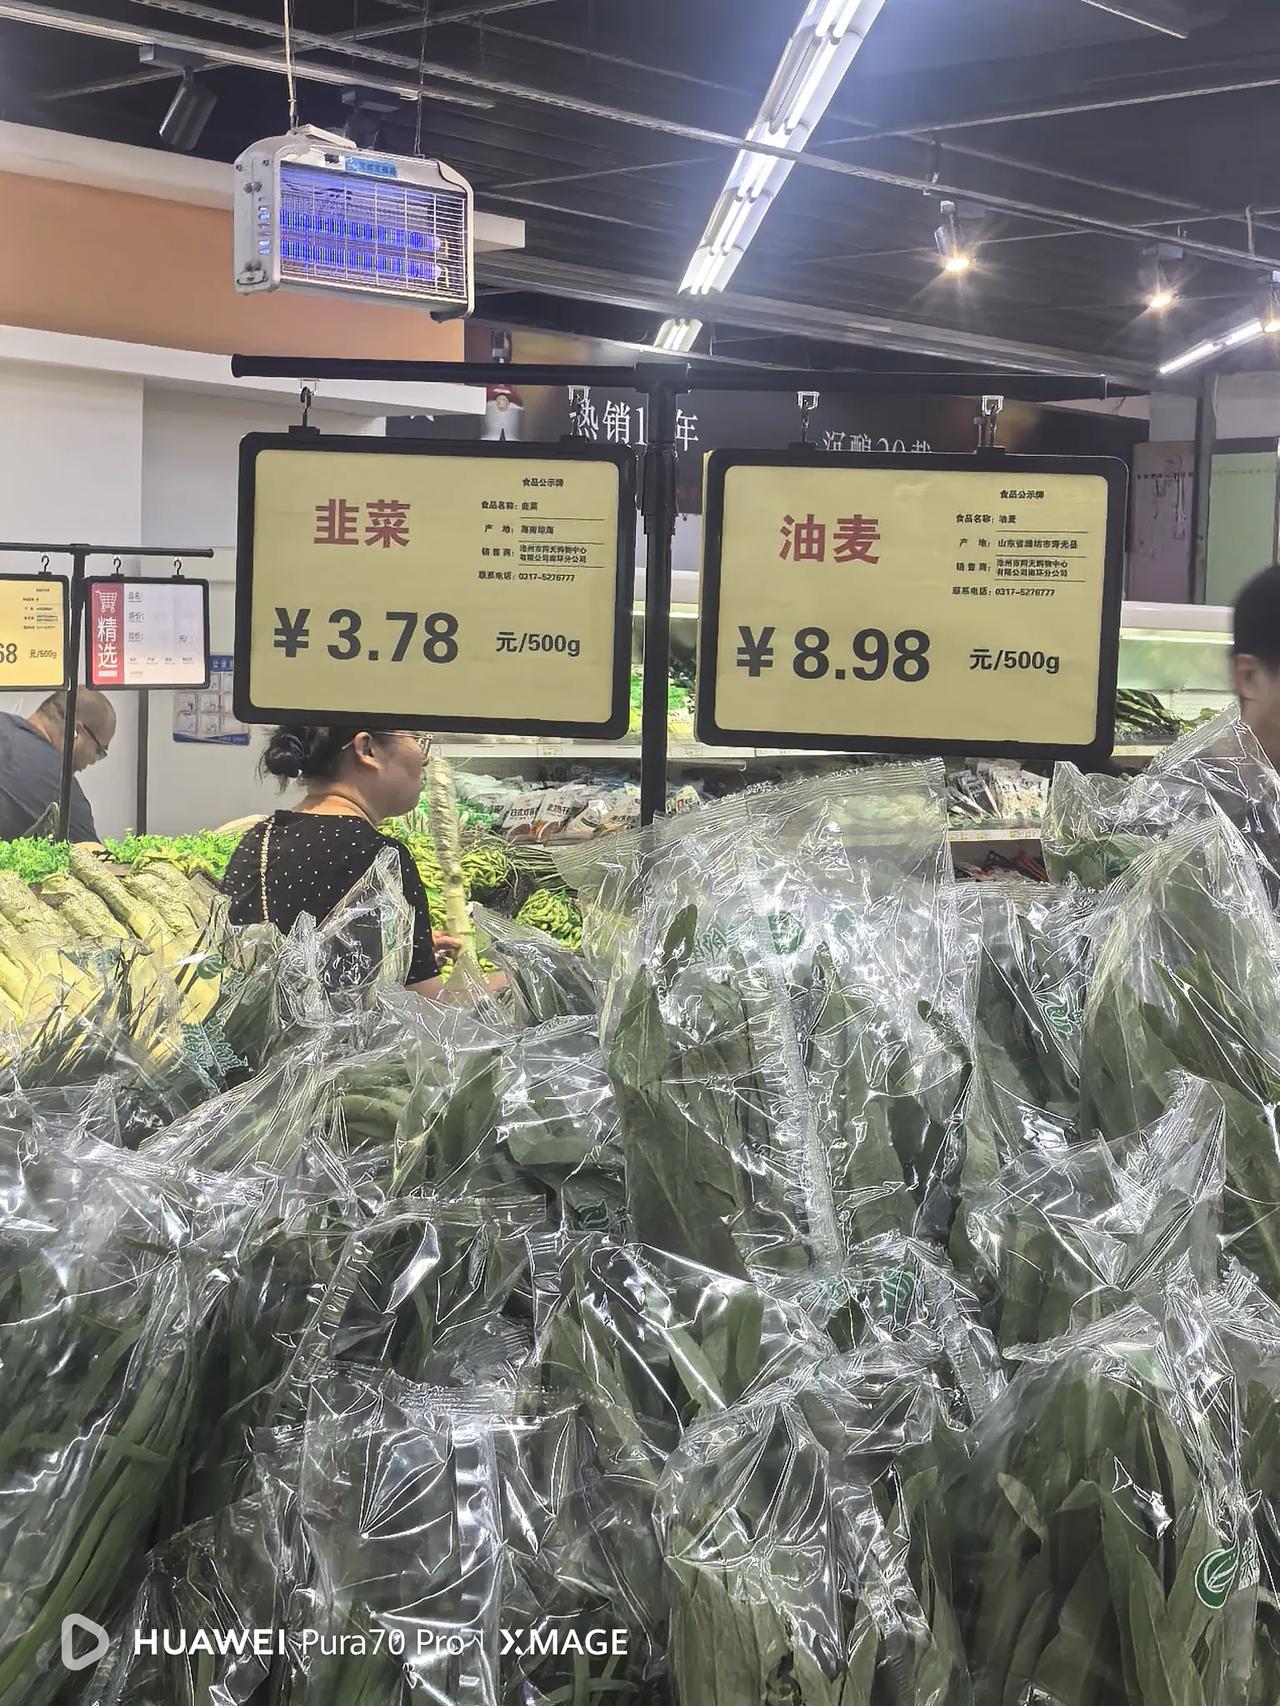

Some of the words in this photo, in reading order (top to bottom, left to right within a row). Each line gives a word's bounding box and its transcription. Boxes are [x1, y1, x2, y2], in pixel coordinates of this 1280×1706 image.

[569, 399, 699, 451] 热销1年
[1000, 490, 1044, 499] 食品公示牌
[314, 498, 411, 549] 韭菜
[778, 513, 881, 564] 油麦
[97, 616, 119, 669] 精选
[327, 608, 459, 664] 3.78
[496, 632, 581, 657] 元/500g
[792, 626, 931, 682] 8.98
[969, 648, 1060, 675] 元/500g
